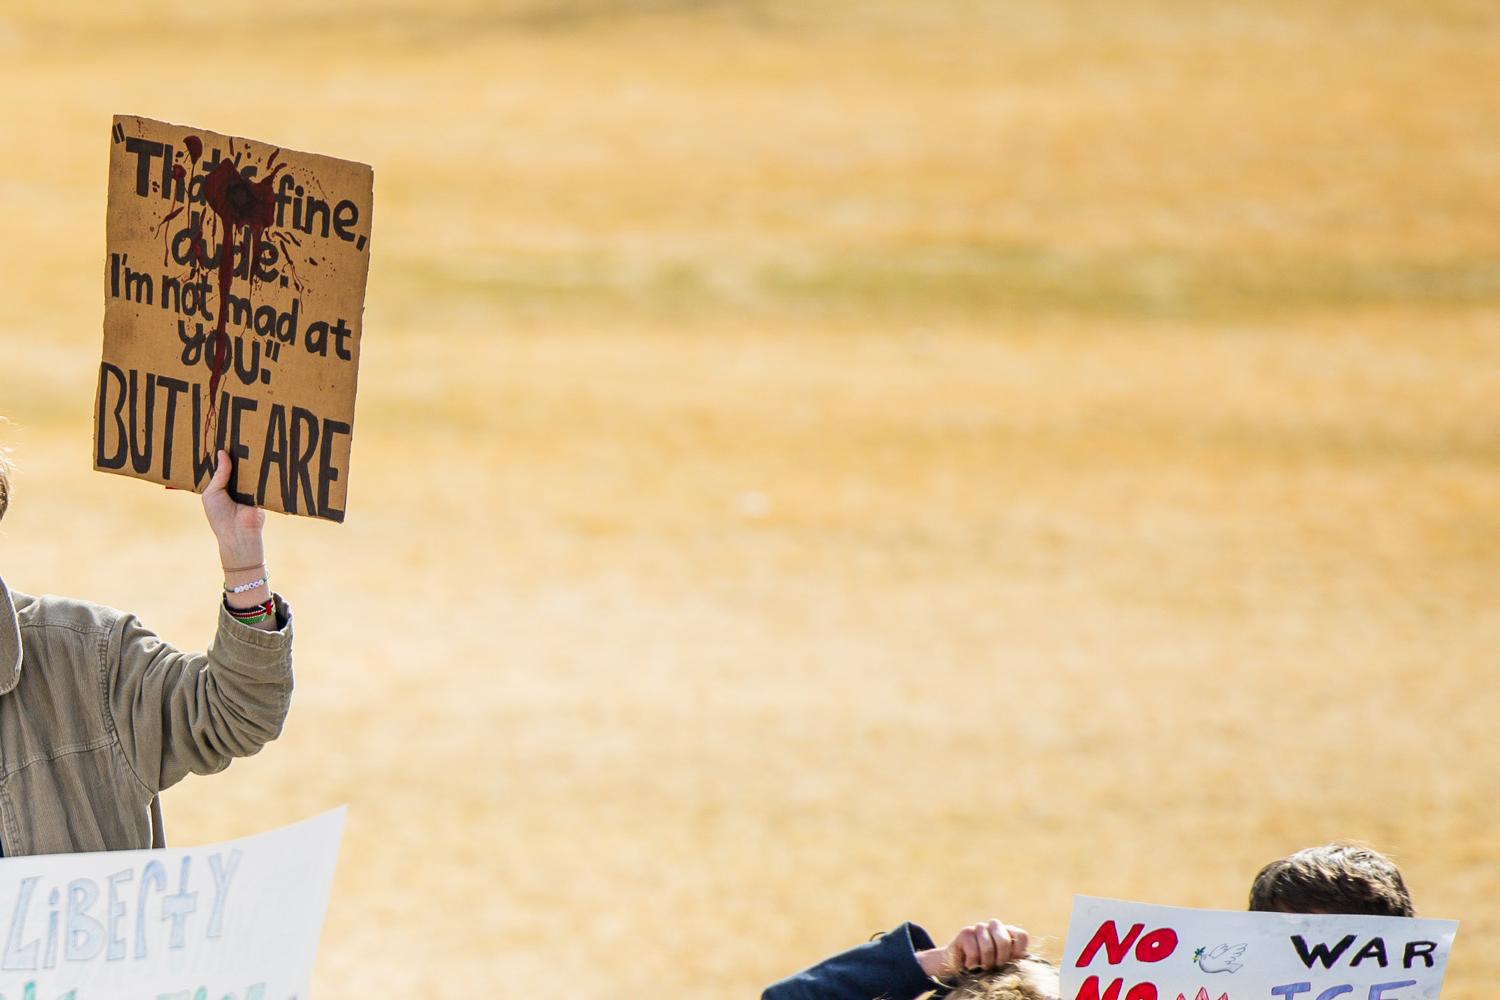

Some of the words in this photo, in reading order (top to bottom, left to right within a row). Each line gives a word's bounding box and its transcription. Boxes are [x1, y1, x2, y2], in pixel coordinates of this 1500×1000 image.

[171, 210, 289, 287] dude.
[274, 173, 368, 252] fine,
[110, 253, 153, 305] I'm
[161, 275, 214, 321] not
[226, 293, 298, 346] mad
[304, 318, 353, 361] at
[97, 361, 189, 480] BUT
[192, 383, 258, 507] WE
[257, 403, 351, 523] ARE
[1076, 920, 1178, 967] NO
[1291, 934, 1438, 969] WAR
